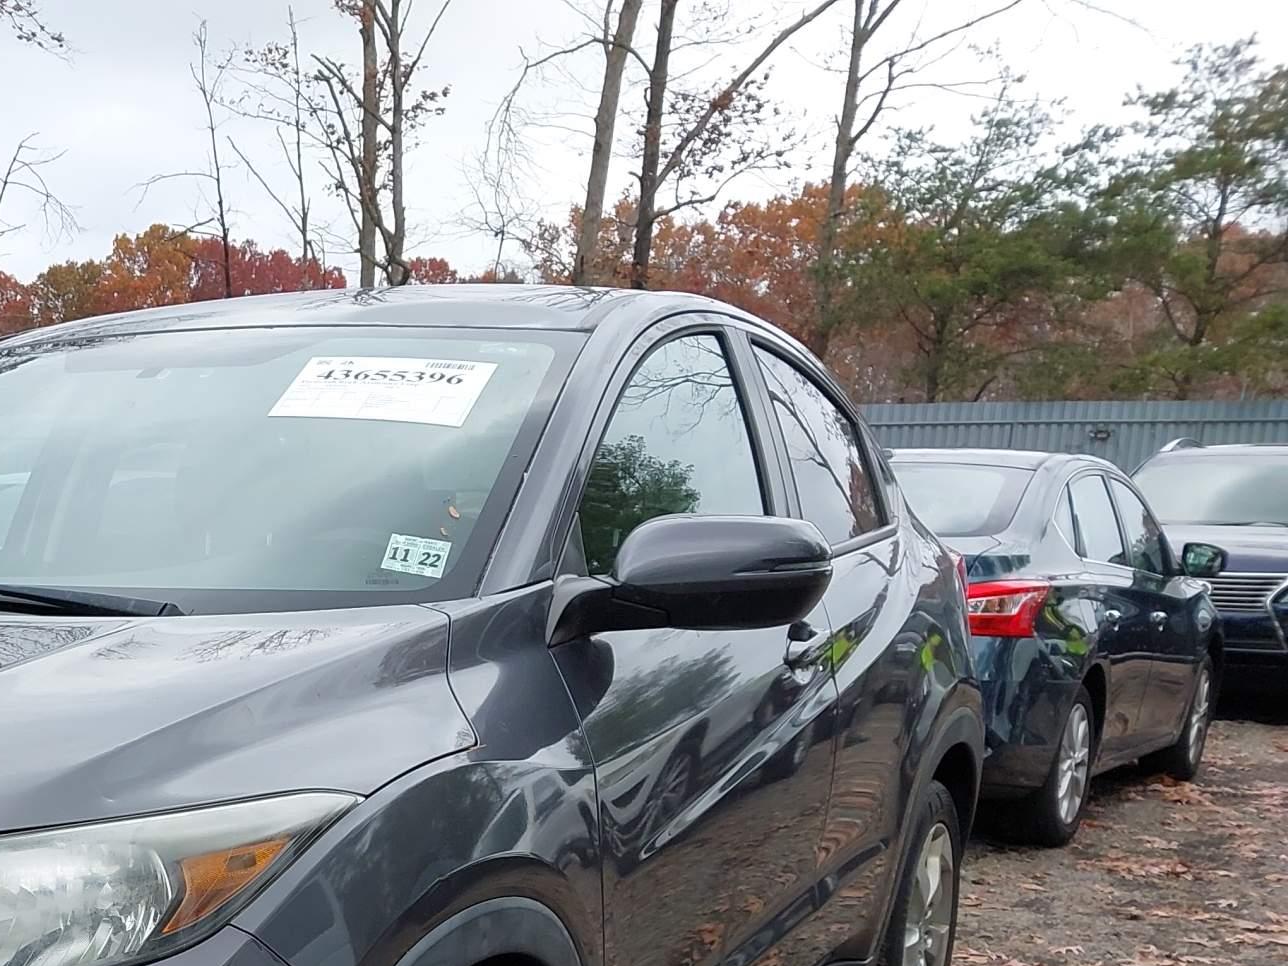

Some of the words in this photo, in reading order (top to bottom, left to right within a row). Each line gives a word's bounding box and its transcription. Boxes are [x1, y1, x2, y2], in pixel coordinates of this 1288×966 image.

[316, 369, 464, 385] 43655396
[389, 546, 410, 563] 11
[418, 551, 441, 568] 22
